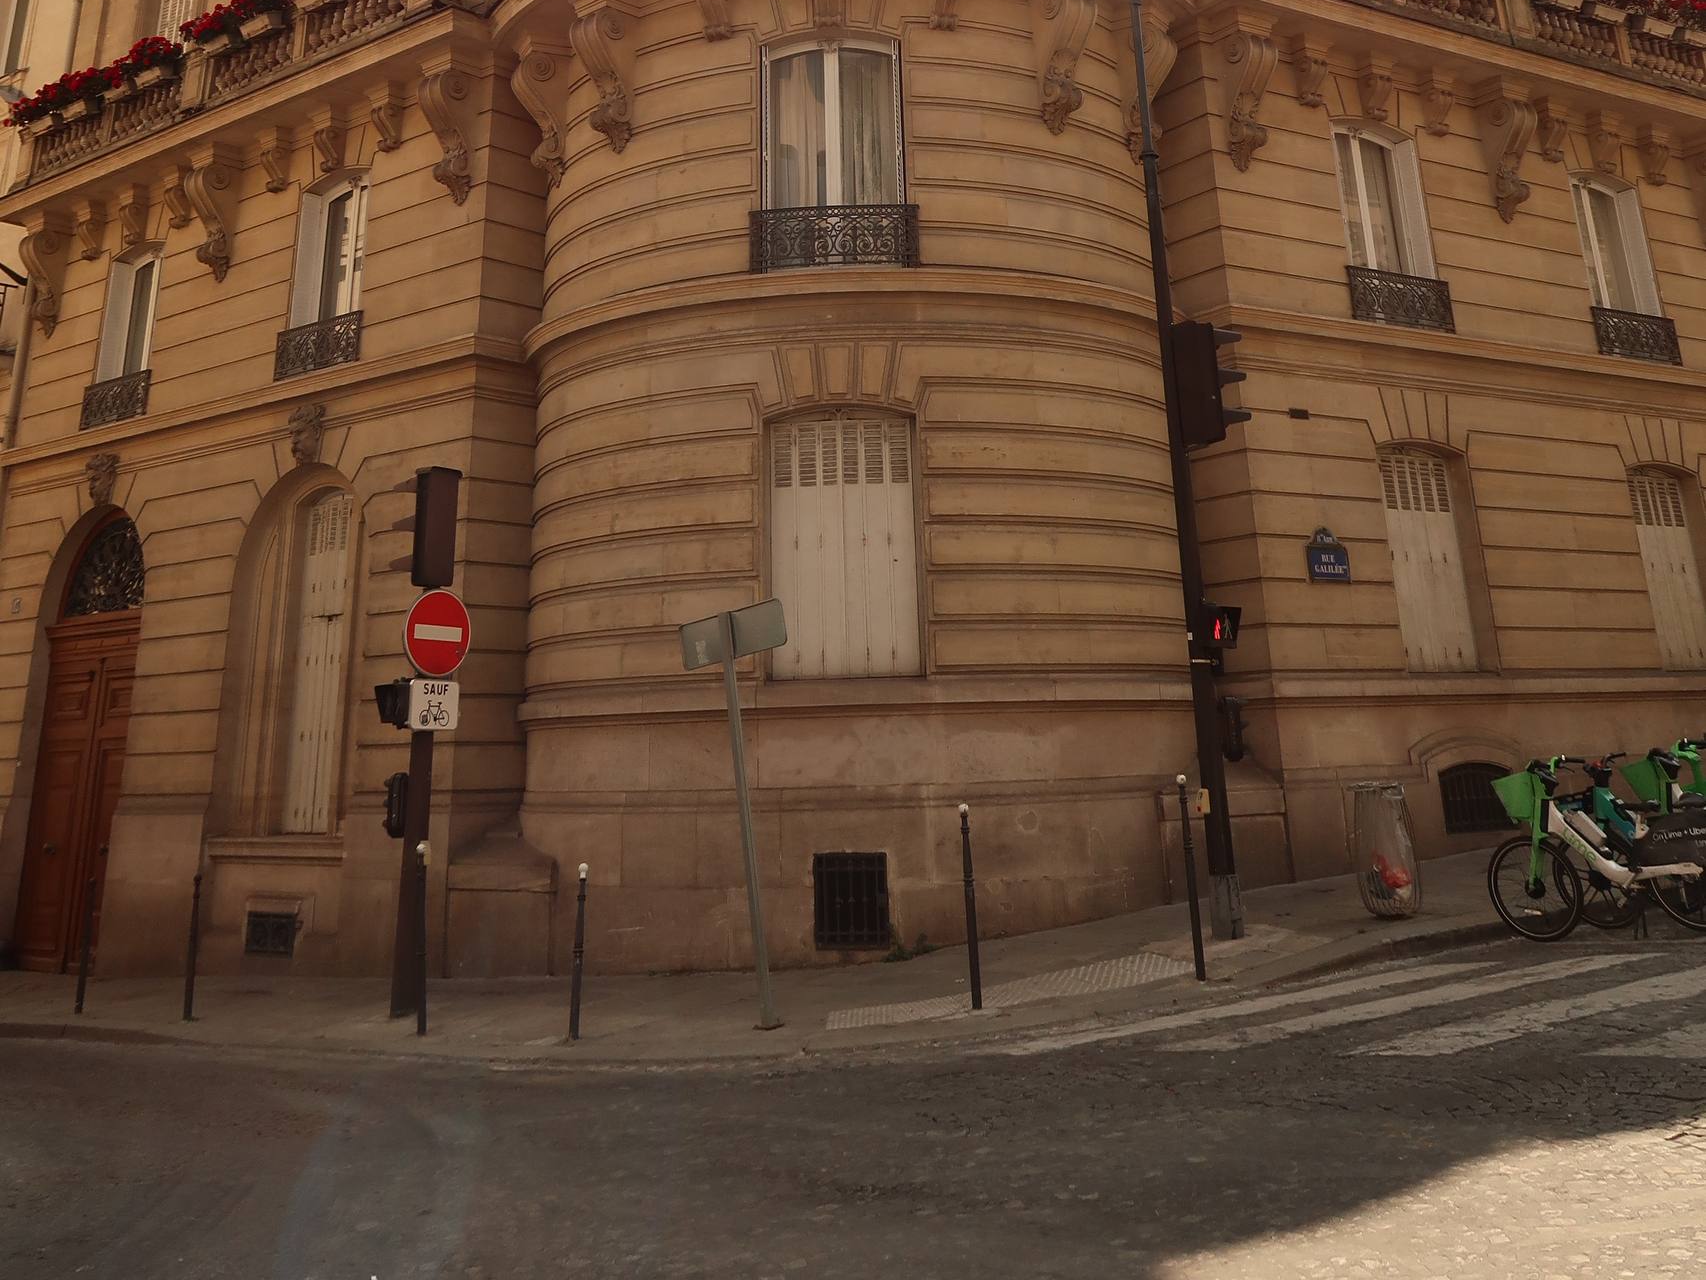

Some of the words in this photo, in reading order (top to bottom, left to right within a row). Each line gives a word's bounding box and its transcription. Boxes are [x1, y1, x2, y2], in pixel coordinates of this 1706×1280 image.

[1321, 554, 1336, 563] RUE
[1314, 564, 1345, 574] GALILÉE
[424, 683, 449, 695] SAUF
